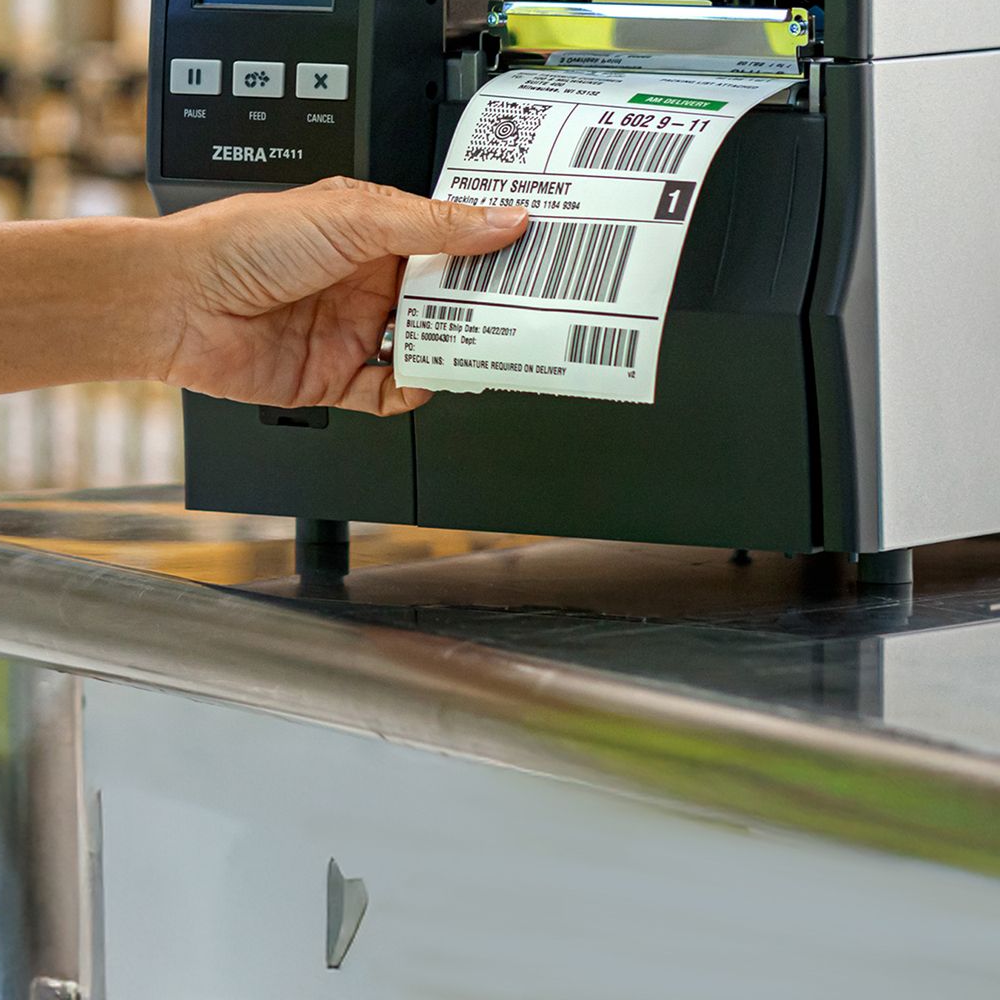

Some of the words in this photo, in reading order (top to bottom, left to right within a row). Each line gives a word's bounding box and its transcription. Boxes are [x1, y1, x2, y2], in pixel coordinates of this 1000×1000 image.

[663, 98, 711, 108] DELIVERY
[183, 108, 207, 119] PAUSE
[249, 111, 267, 121] FEED
[307, 113, 335, 124] CANCEL
[598, 111, 615, 125] IL
[620, 112, 655, 128] 602
[212, 145, 267, 162] ZEBRA
[269, 148, 303, 160] ZT411
[450, 176, 508, 192] PRIORITY
[510, 179, 572, 195] SHIPMENT
[447, 193, 479, 206] Tracking
[668, 189, 681, 213] 1
[407, 307, 419, 317] PO:
[406, 319, 433, 330] BILLING:
[449, 323, 463, 333] Ship
[464, 324, 480, 334] Date:
[482, 326, 517, 337] 04/22/2017
[405, 331, 419, 340] DEL:
[461, 335, 477, 346] Dept:
[404, 342, 415, 351] PO:
[404, 353, 430, 364] SPECIAL
[432, 356, 445, 365] INS:
[453, 357, 489, 370] SIGNATURE
[490, 361, 523, 372] REQUIRED
[524, 363, 534, 373] ON
[536, 365, 567, 376] DELIVERY
